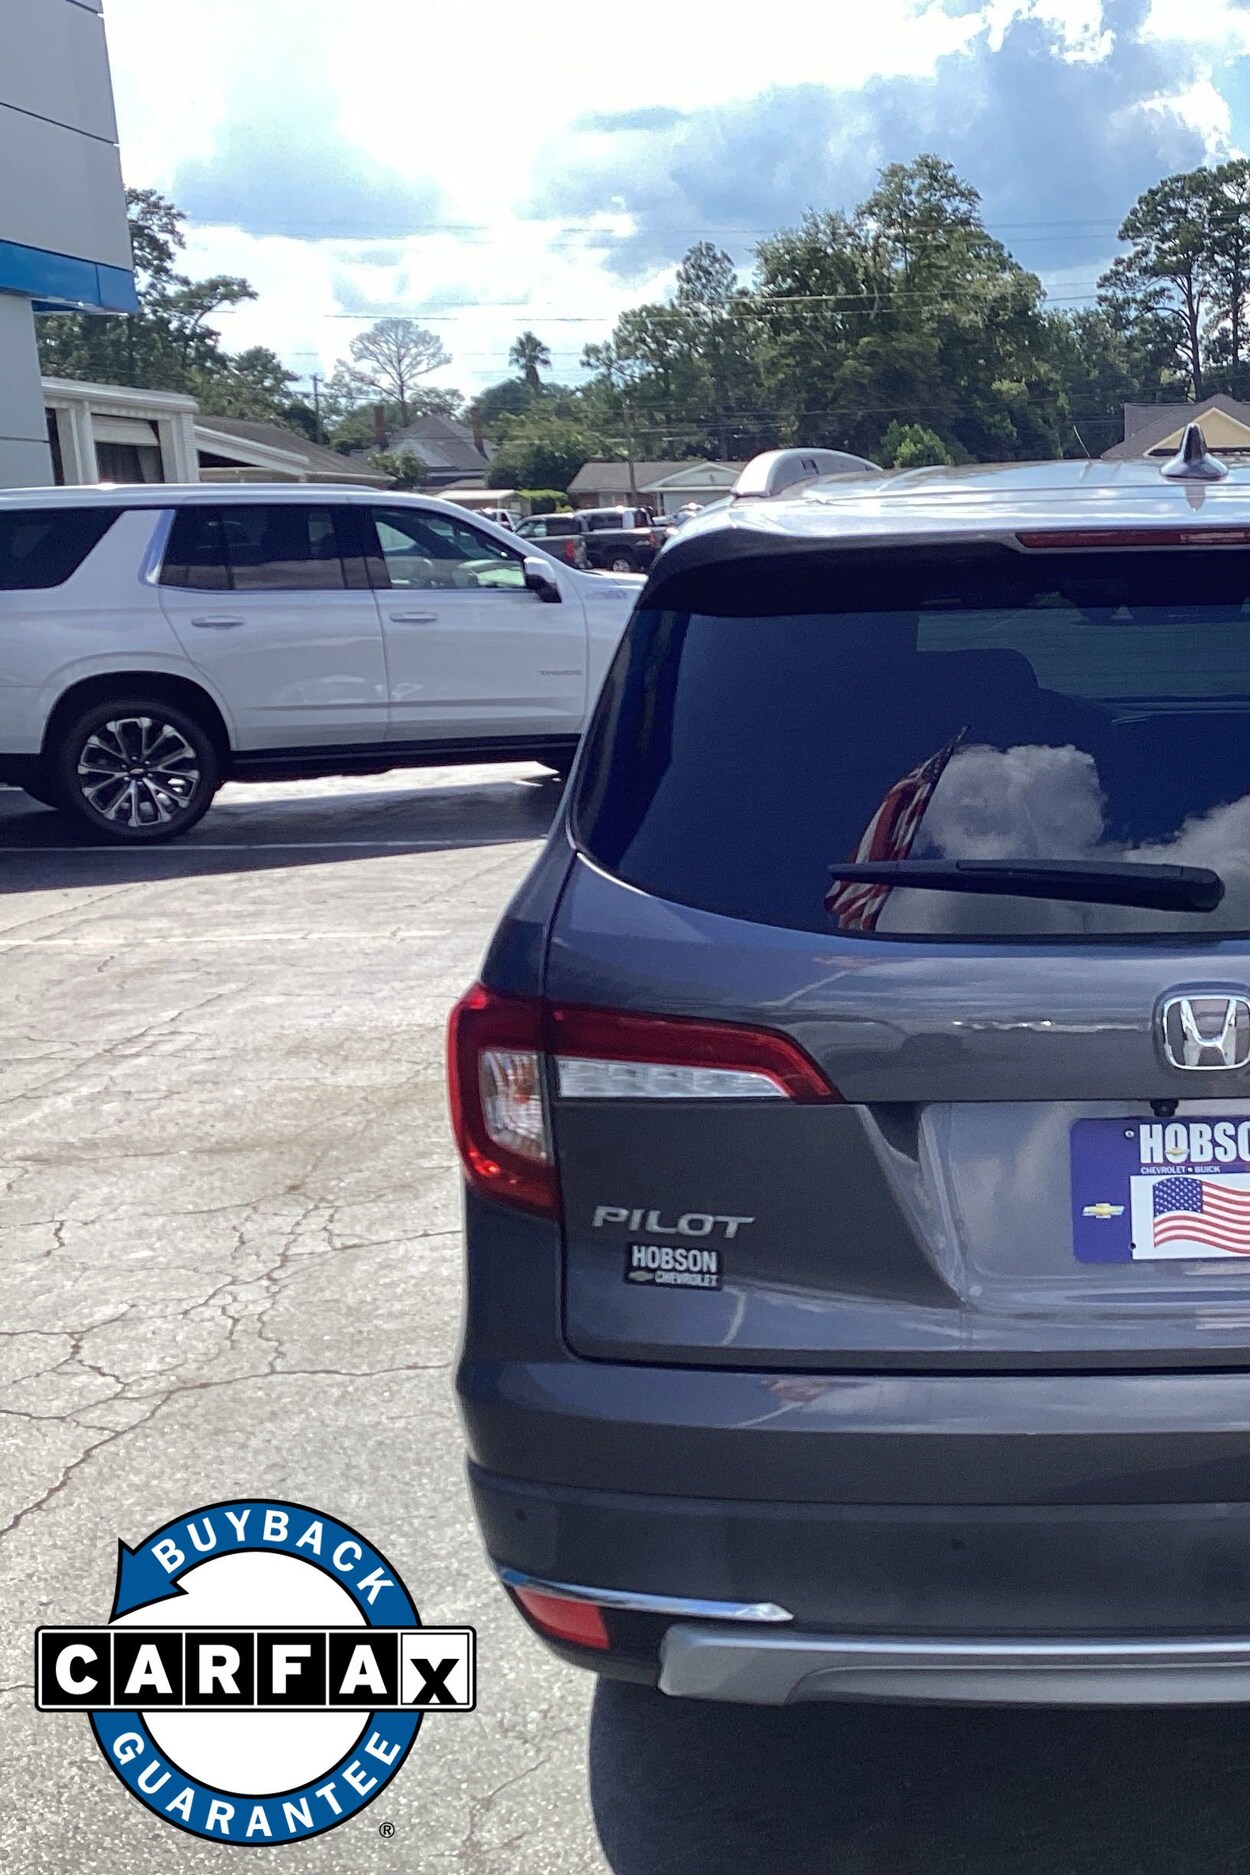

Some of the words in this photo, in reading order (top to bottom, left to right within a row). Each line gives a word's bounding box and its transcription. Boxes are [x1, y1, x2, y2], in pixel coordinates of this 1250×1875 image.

[1140, 1165, 1186, 1174] CHEVROLET
[1194, 1165, 1220, 1173] BUICK
[592, 1205, 755, 1239] PILOT
[631, 1245, 718, 1273] HOBSON
